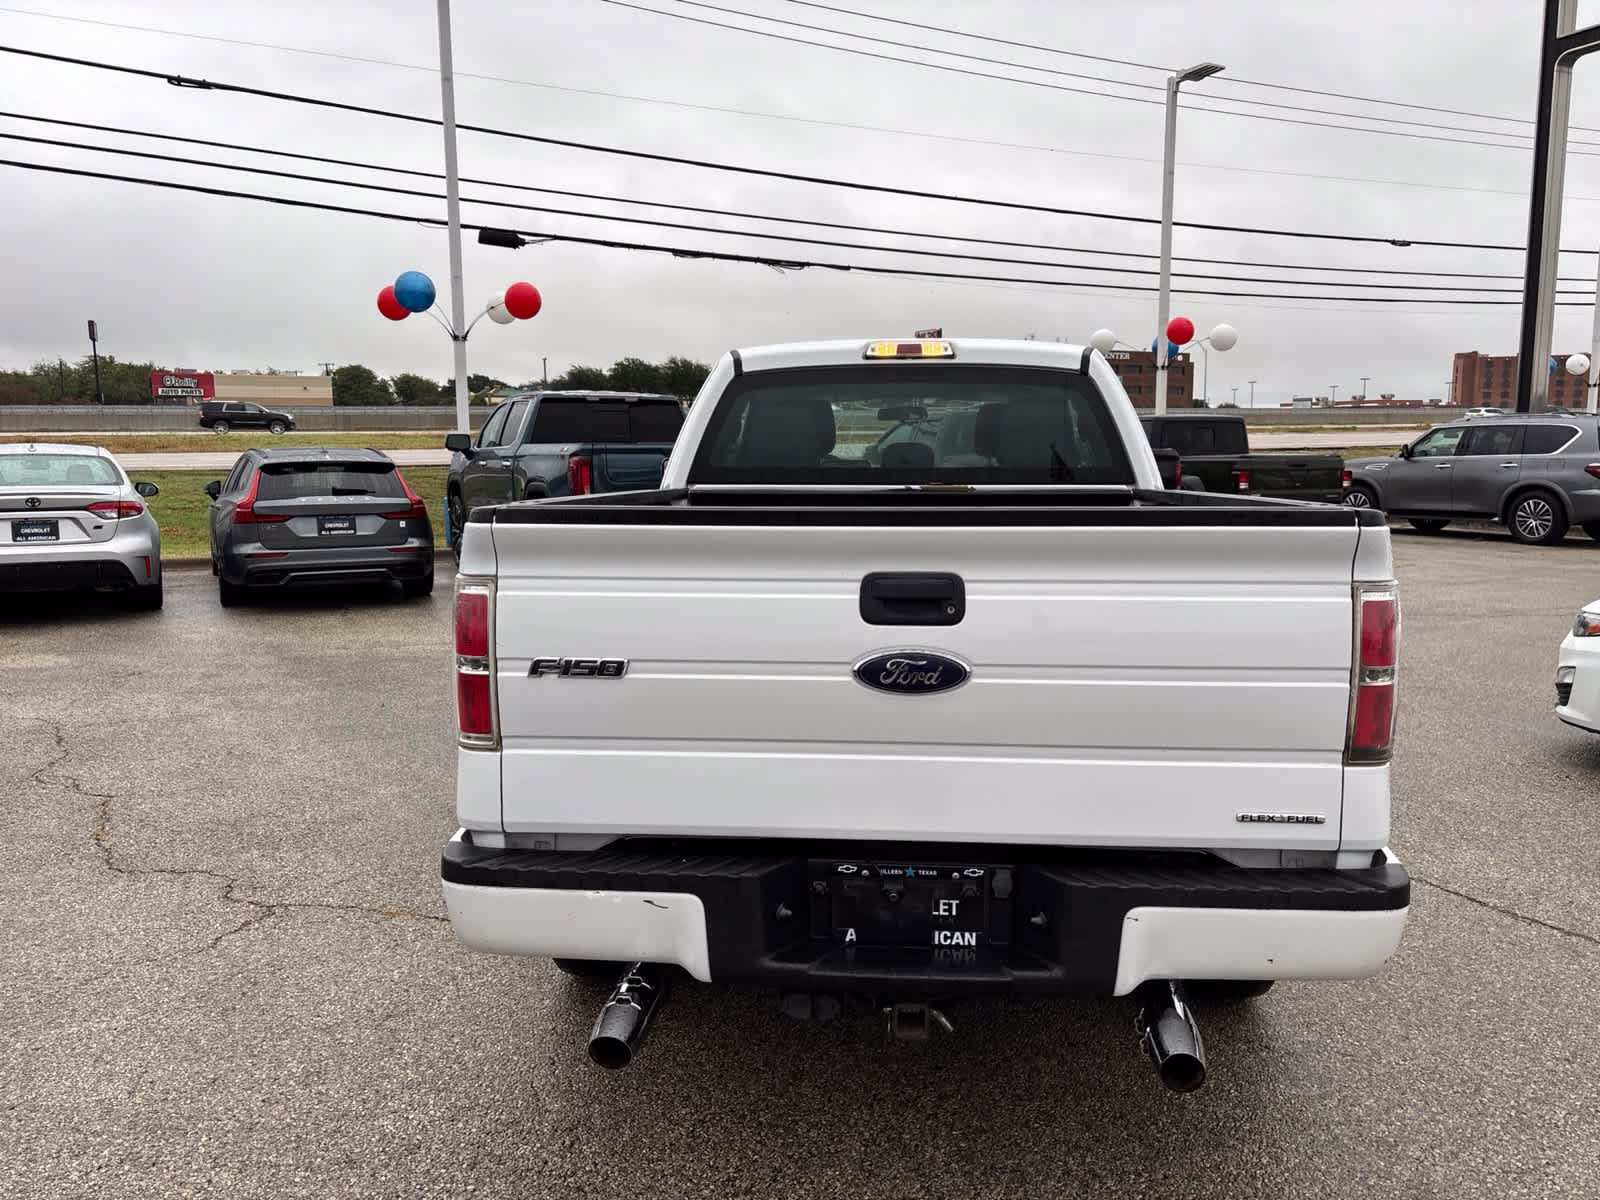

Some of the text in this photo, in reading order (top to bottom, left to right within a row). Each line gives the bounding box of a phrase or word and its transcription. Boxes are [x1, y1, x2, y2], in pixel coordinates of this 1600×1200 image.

[1104, 352, 1130, 360] ENTER
[880, 659, 943, 685] Ford
[1237, 813, 1325, 825] FLEX FUEL
[880, 868, 904, 876] ILLEEN
[934, 930, 977, 946] ICAN
